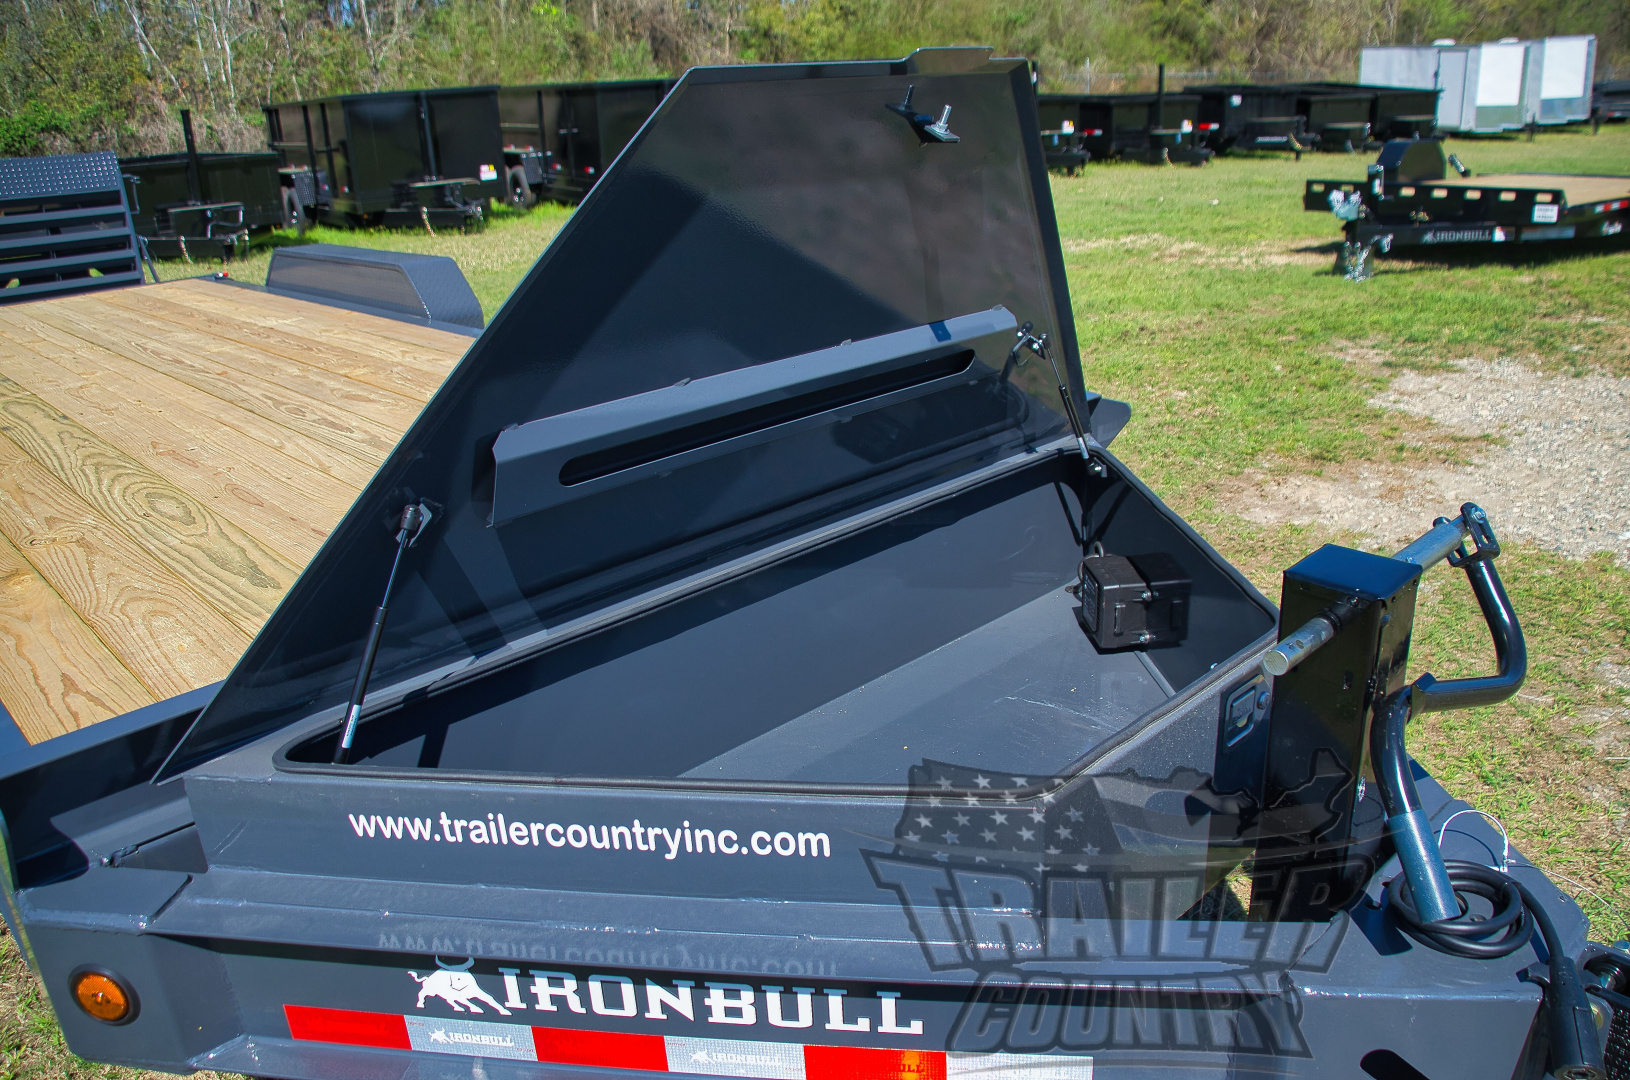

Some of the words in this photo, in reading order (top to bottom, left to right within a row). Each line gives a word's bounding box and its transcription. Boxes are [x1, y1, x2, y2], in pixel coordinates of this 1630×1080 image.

[1436, 229, 1492, 242] IRONBULL
[348, 811, 831, 860] www.trailercountryinc.com
[498, 966, 924, 1036] IRONBULL
[448, 1032, 514, 1047] IRONBULL
[711, 1052, 780, 1066] IRONBULL
